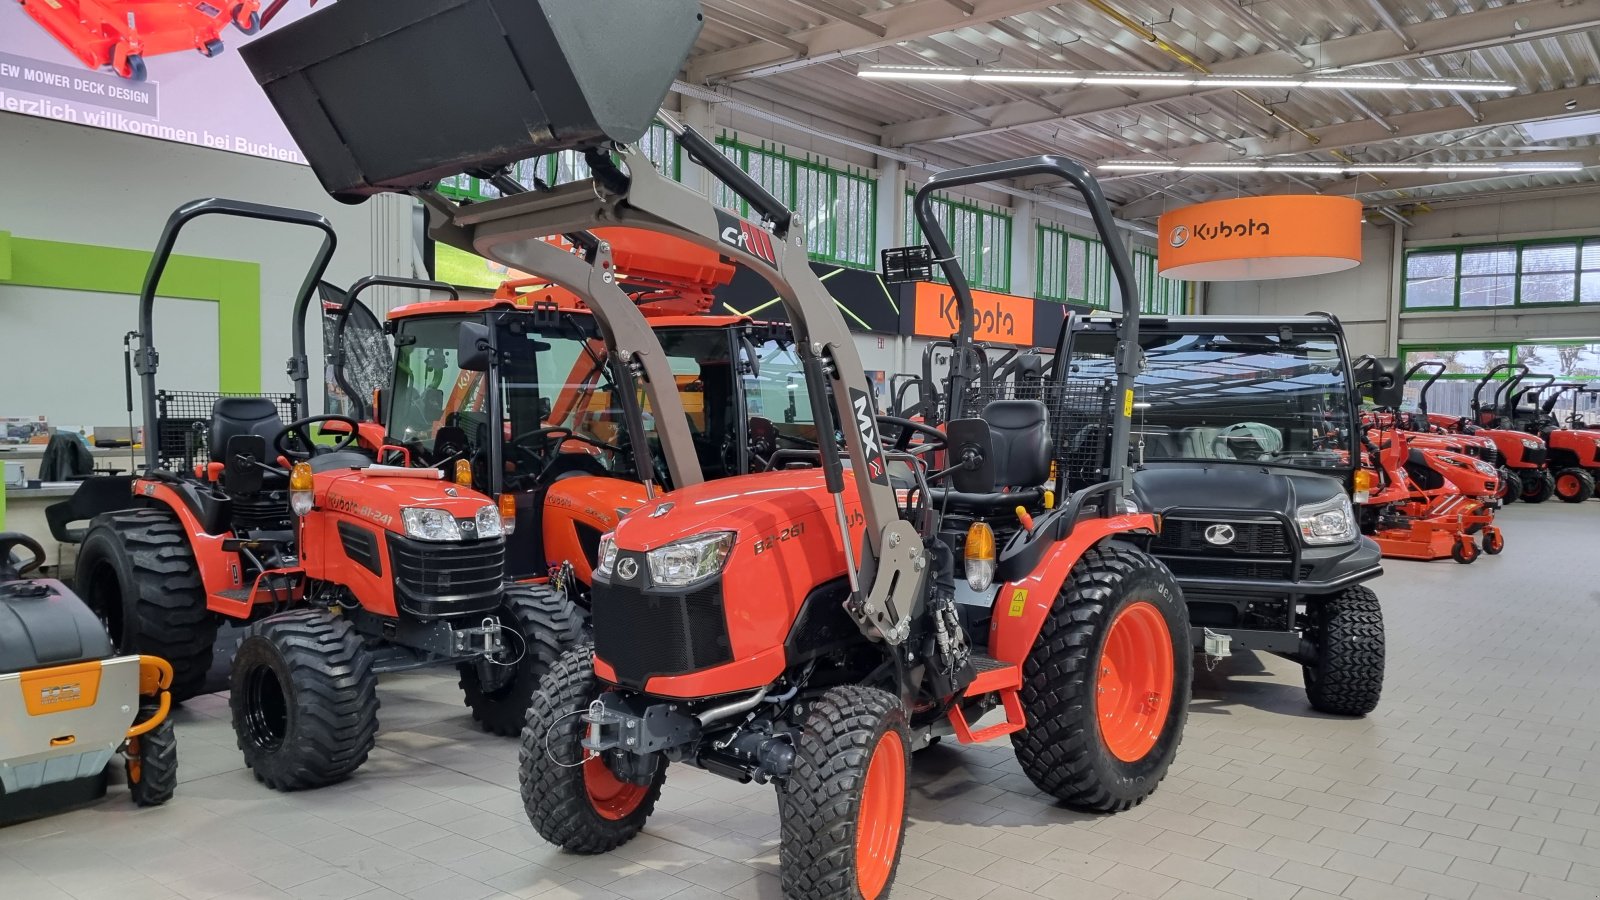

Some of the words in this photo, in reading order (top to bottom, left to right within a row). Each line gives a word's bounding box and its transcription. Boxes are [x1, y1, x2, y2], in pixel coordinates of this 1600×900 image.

[24, 68, 70, 88] MOWER
[74, 78, 105, 95] DECK
[108, 86, 149, 104] DESIGN
[83, 110, 197, 143] willkommen
[203, 130, 230, 149] bei
[235, 136, 298, 162] Buchen
[1193, 218, 1270, 240] Kubota
[854, 395, 879, 459] MX
